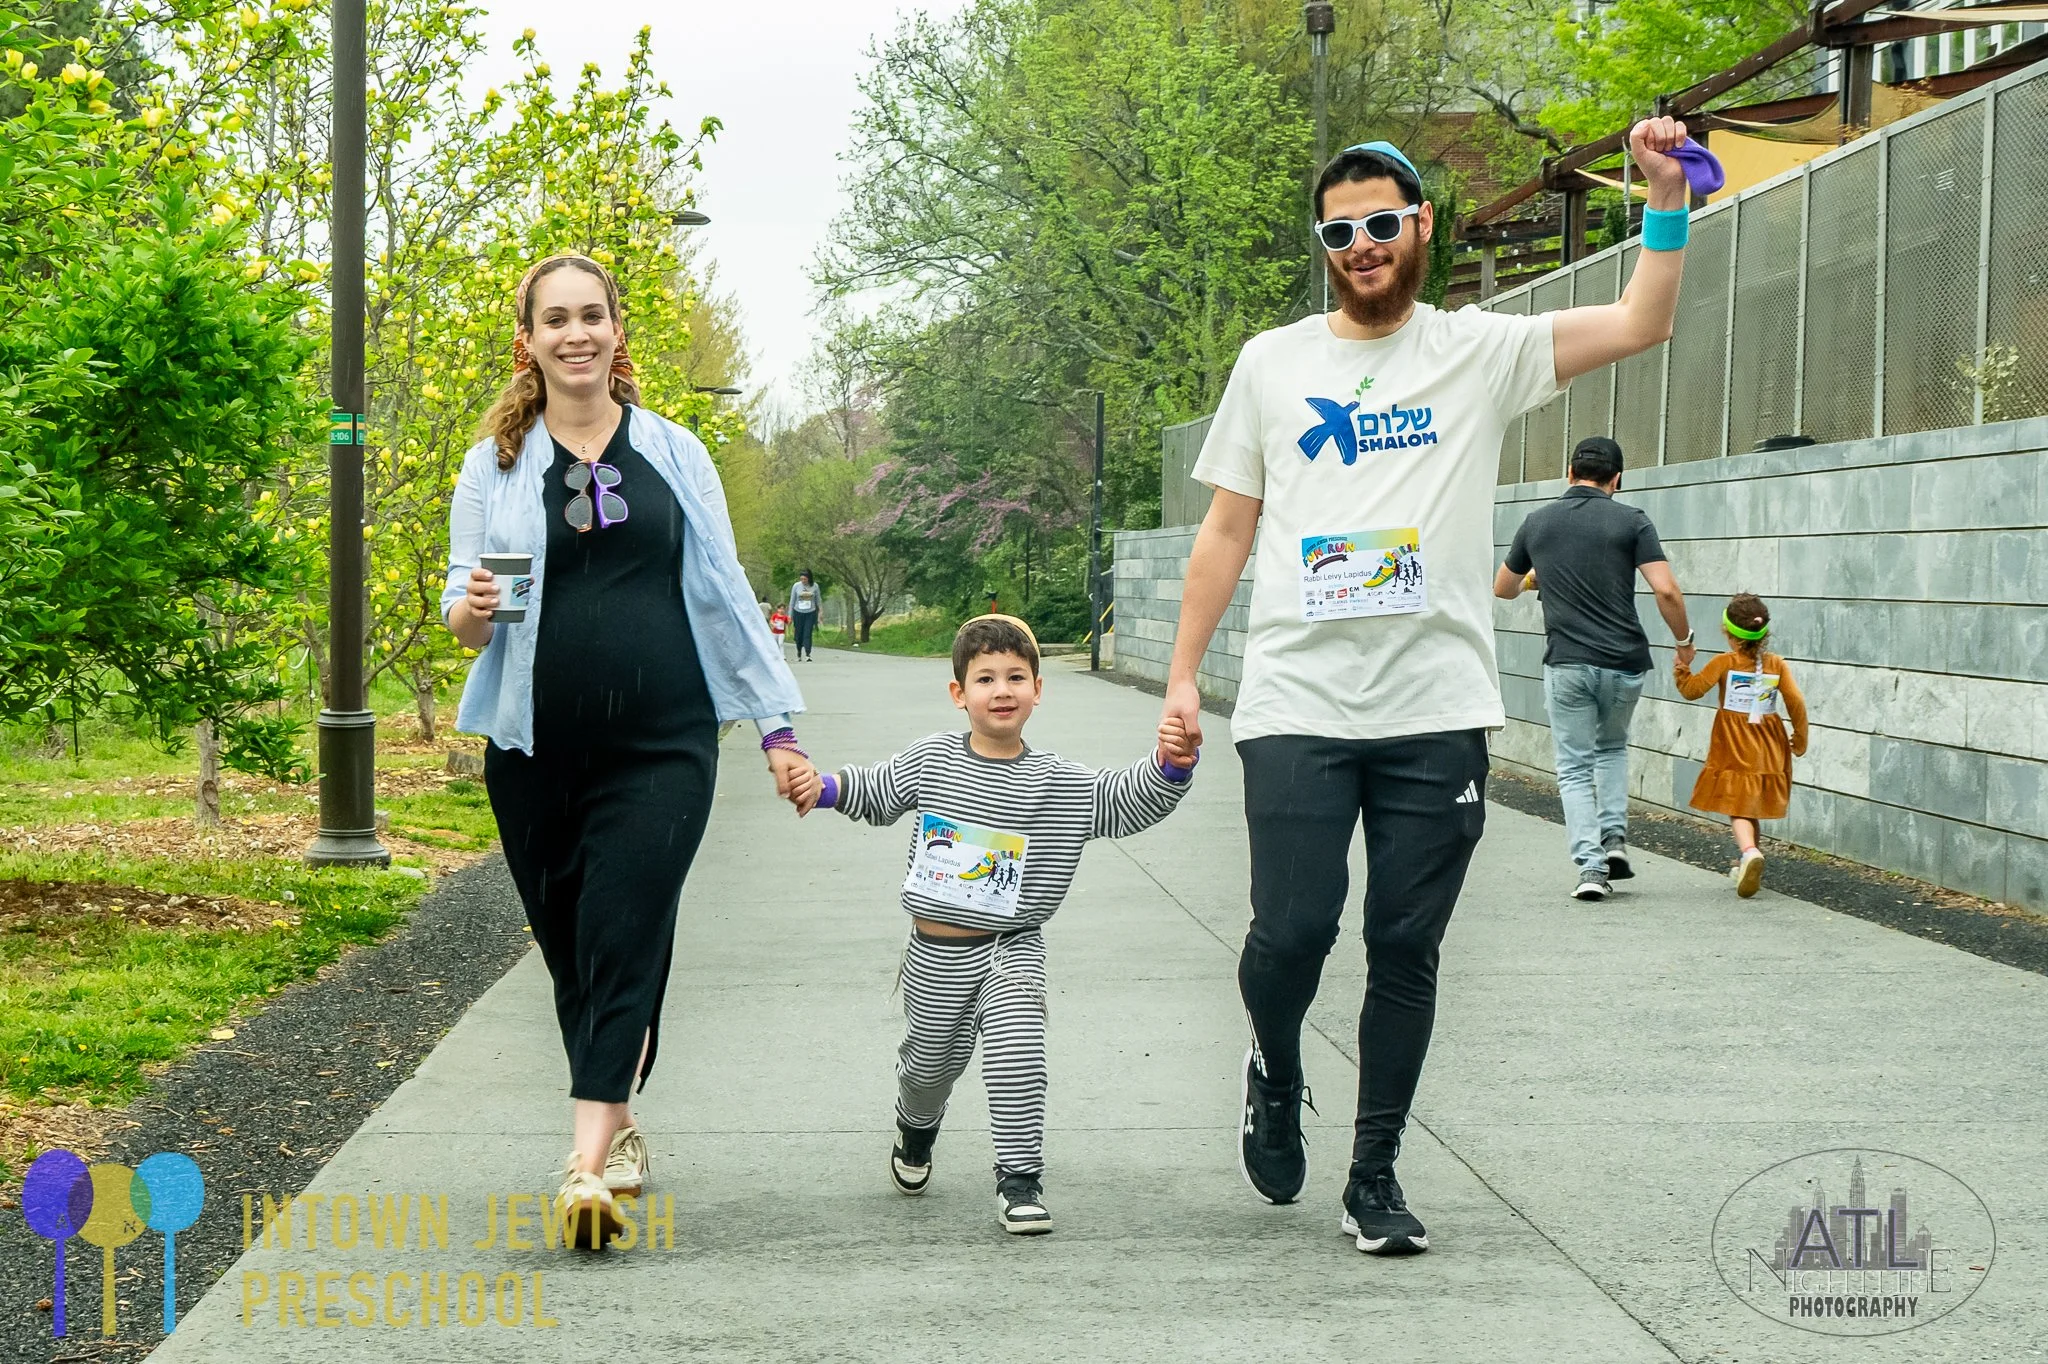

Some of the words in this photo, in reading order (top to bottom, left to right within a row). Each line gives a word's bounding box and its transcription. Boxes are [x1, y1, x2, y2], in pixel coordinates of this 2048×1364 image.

[1357, 404, 1432, 437] שלום
[1358, 431, 1438, 453] SHALOM
[1302, 547, 1323, 568] FUN
[1327, 542, 1355, 553] RUN
[1303, 575, 1322, 583] Rabbi
[1343, 569, 1372, 579] Lapidus
[923, 828, 938, 842] FUN
[940, 828, 962, 842] RUN
